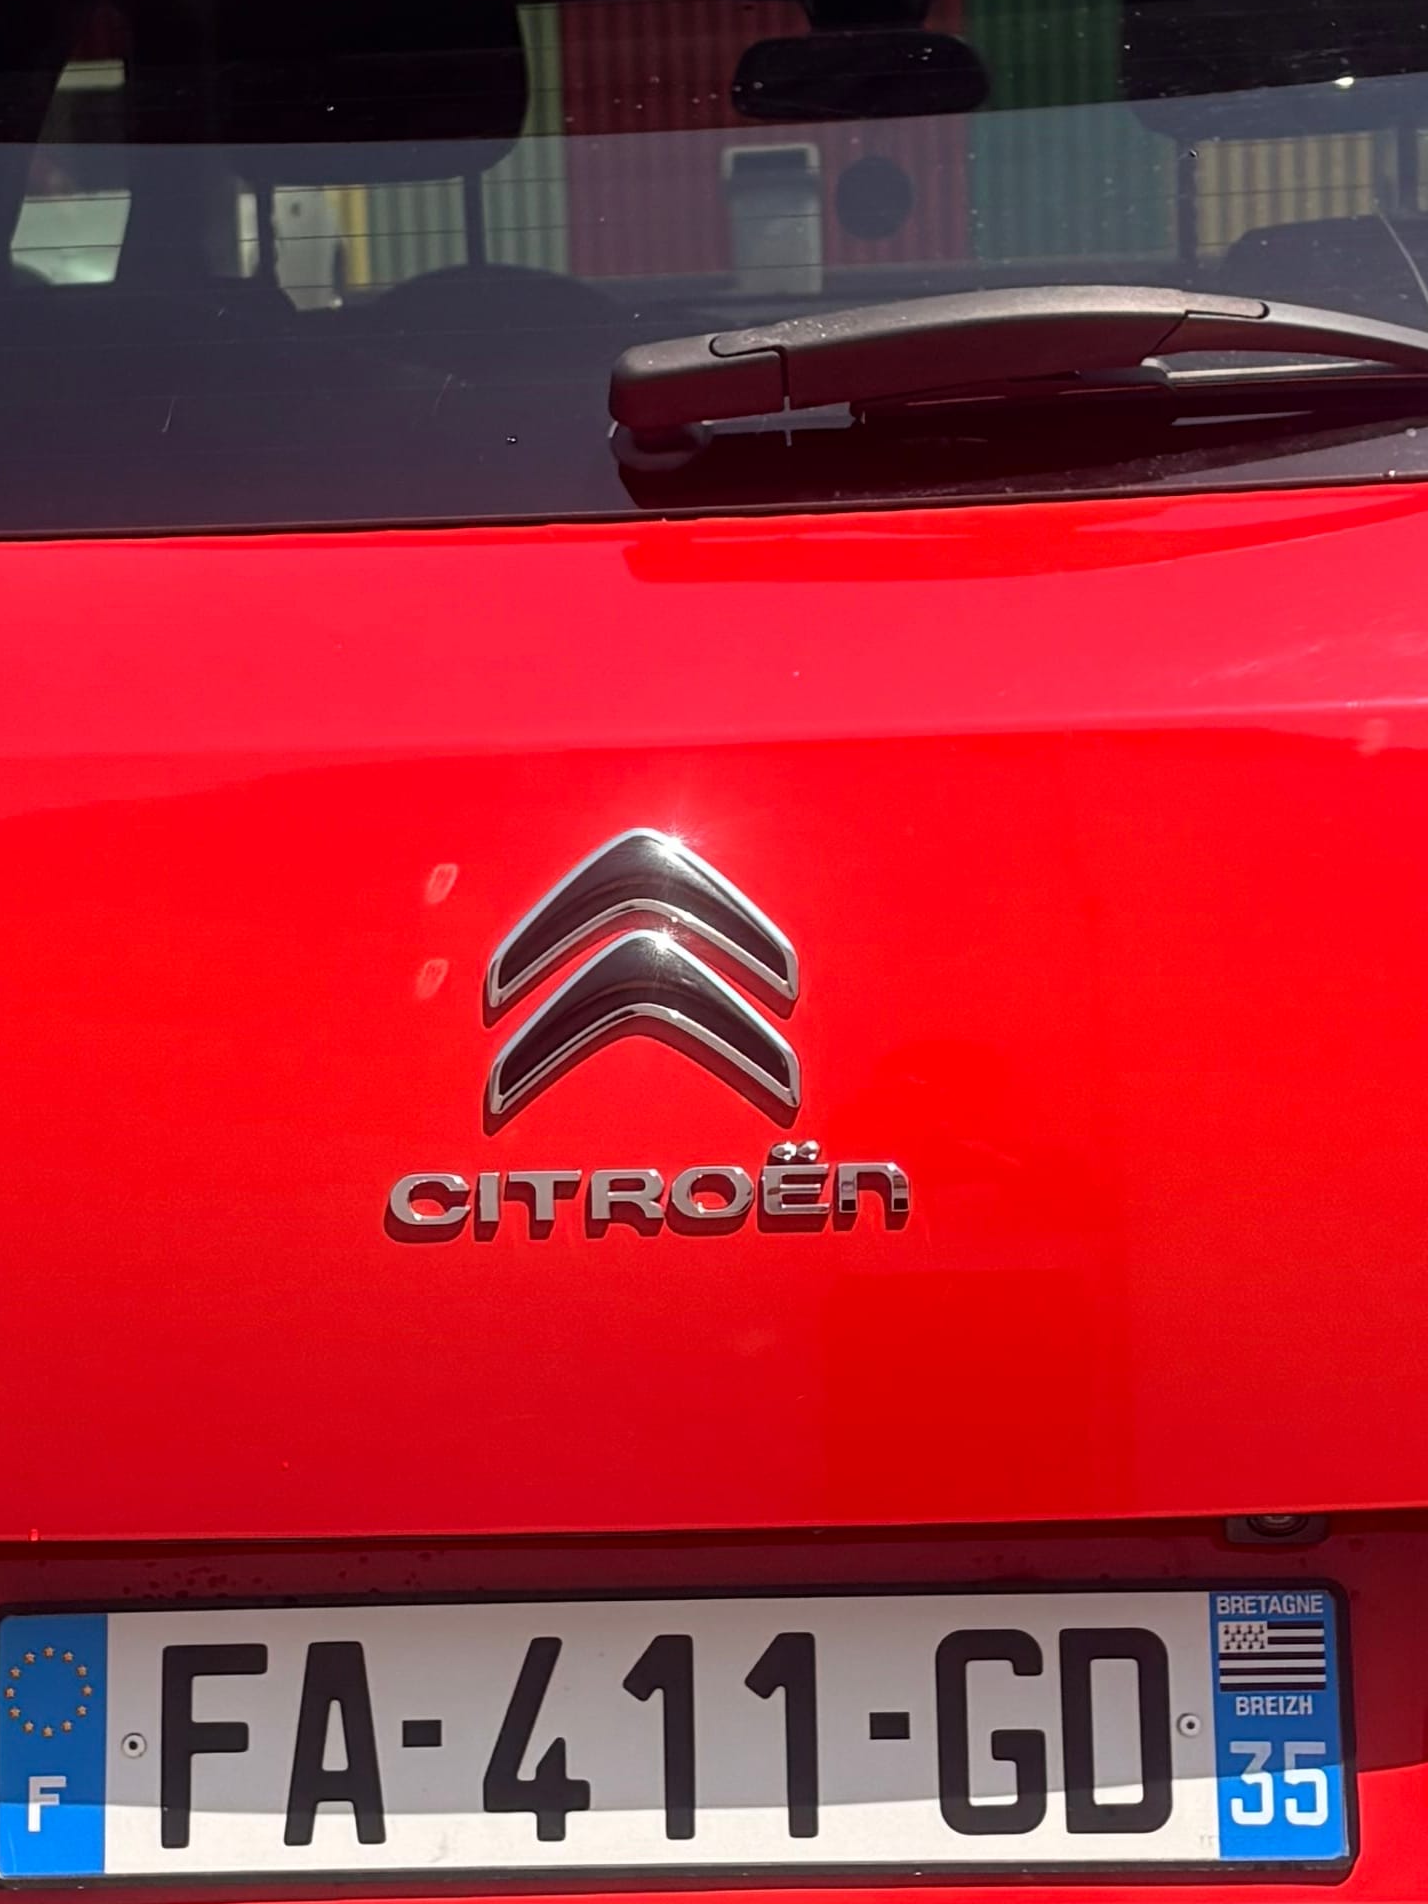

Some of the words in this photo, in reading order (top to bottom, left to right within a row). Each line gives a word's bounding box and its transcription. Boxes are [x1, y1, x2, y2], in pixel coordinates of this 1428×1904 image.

[1216, 1595, 1324, 1616] BRETAGNE
[1235, 1696, 1314, 1717] BREIZH
[160, 1627, 1173, 1850] FA-411-GD
[27, 1775, 68, 1834] F
[1229, 1741, 1329, 1827] 35
